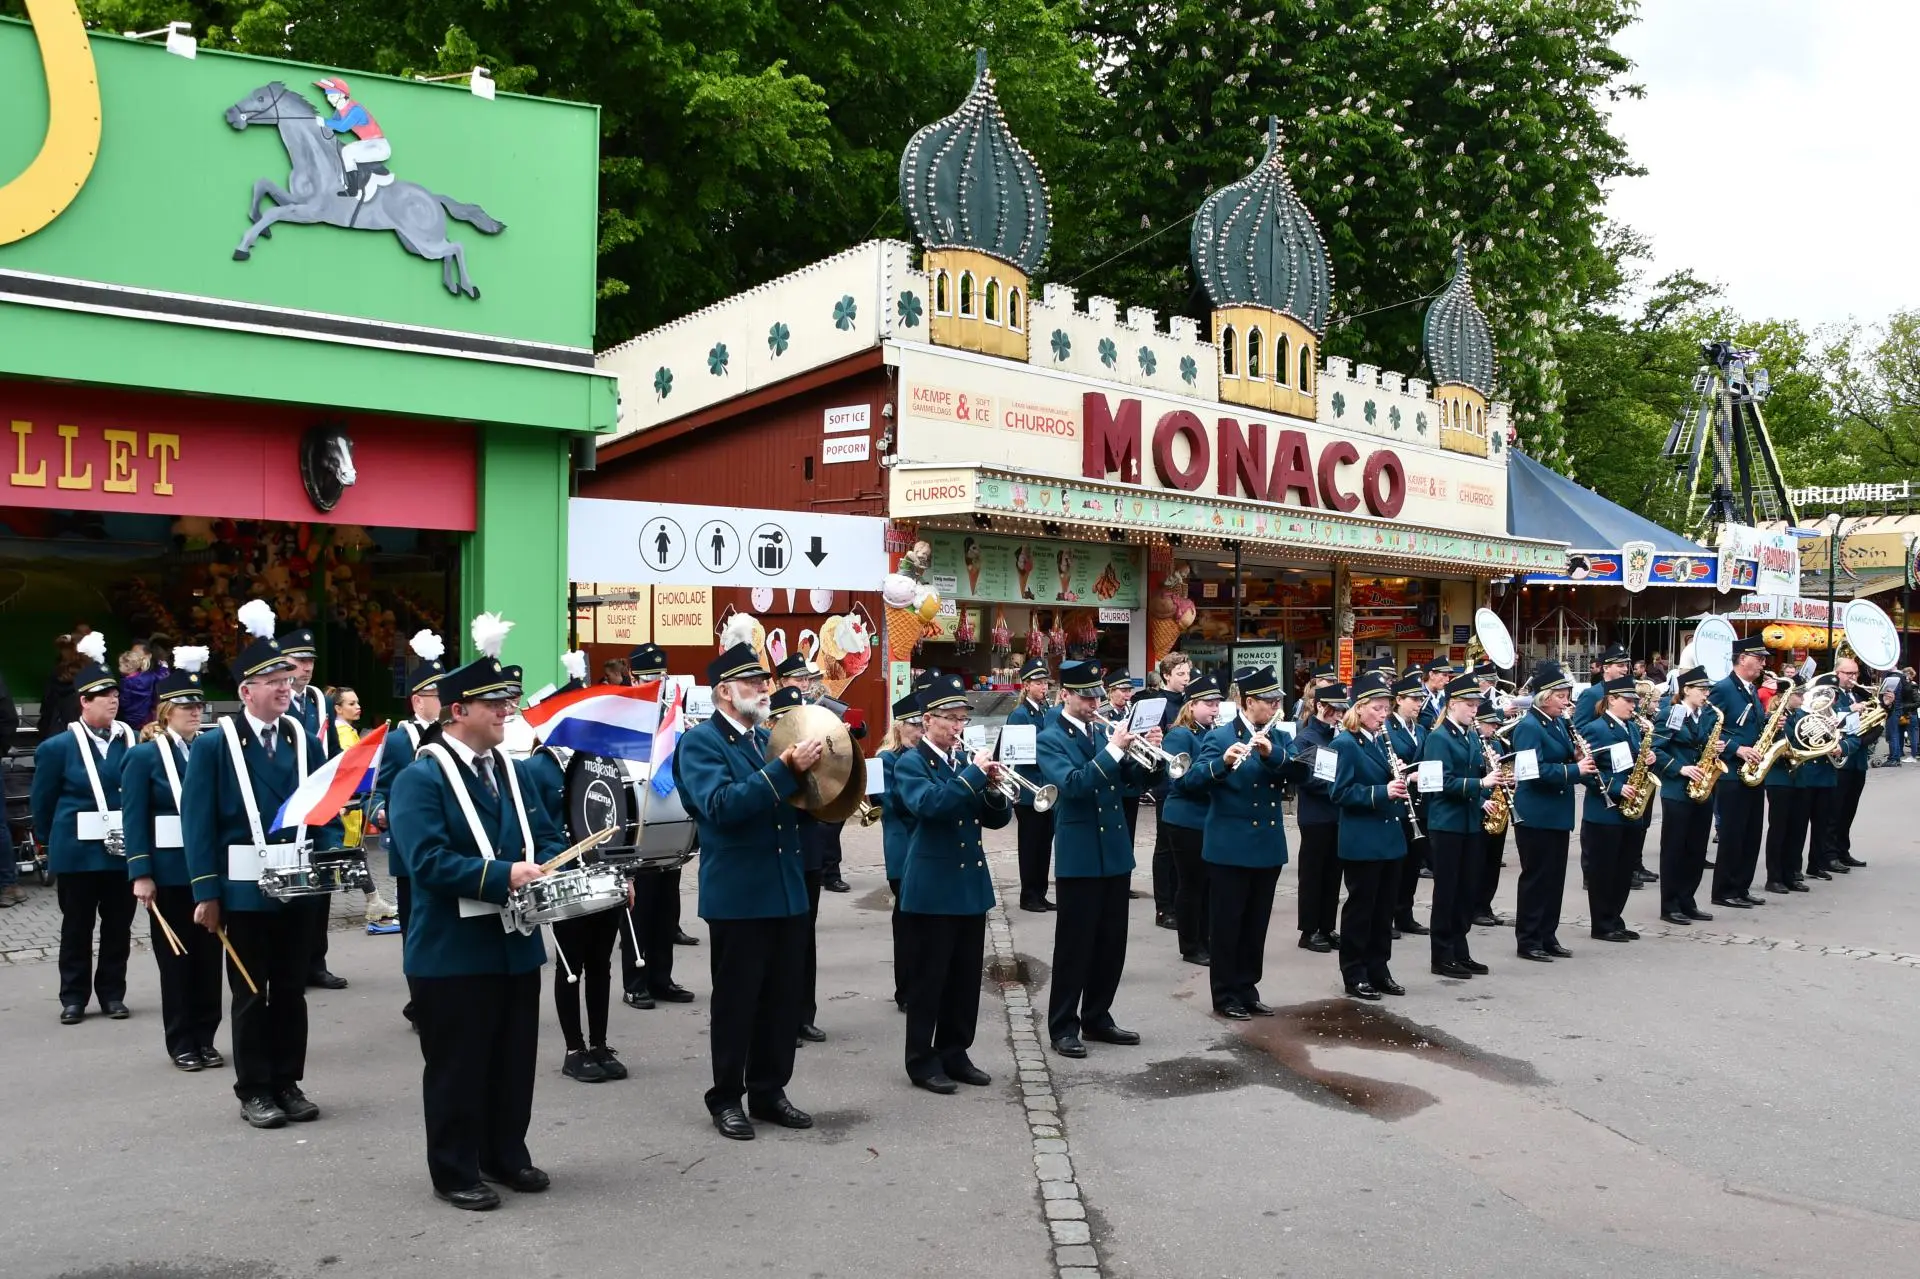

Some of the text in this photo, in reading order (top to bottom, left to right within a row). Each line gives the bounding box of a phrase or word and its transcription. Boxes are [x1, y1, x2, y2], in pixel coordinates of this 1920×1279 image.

[913, 387, 952, 405] KÆMPE
[975, 397, 990, 407] SOFT
[912, 403, 952, 416] GAMMELDAGS
[975, 408, 990, 422] ICE
[829, 411, 865, 425] SOFT ICE
[1005, 411, 1075, 437] CHURROS
[826, 443, 866, 455] POPCORN
[1082, 391, 1406, 519] MONACO
[11, 420, 180, 496] LLET
[905, 485, 966, 501] CHURROS
[1459, 489, 1494, 506] CHURROS
[1789, 480, 1910, 506] URLUMHEJ
[657, 591, 707, 605] CHOKOLADE
[608, 601, 638, 611] POPCORN
[607, 614, 637, 625] SLUSH ICE
[661, 613, 703, 627] SLIKPINDE
[1100, 612, 1130, 622] CHURROS
[615, 629, 631, 639] VAND
[1237, 651, 1277, 659] MONACO'S
[584, 757, 618, 779] majestic
